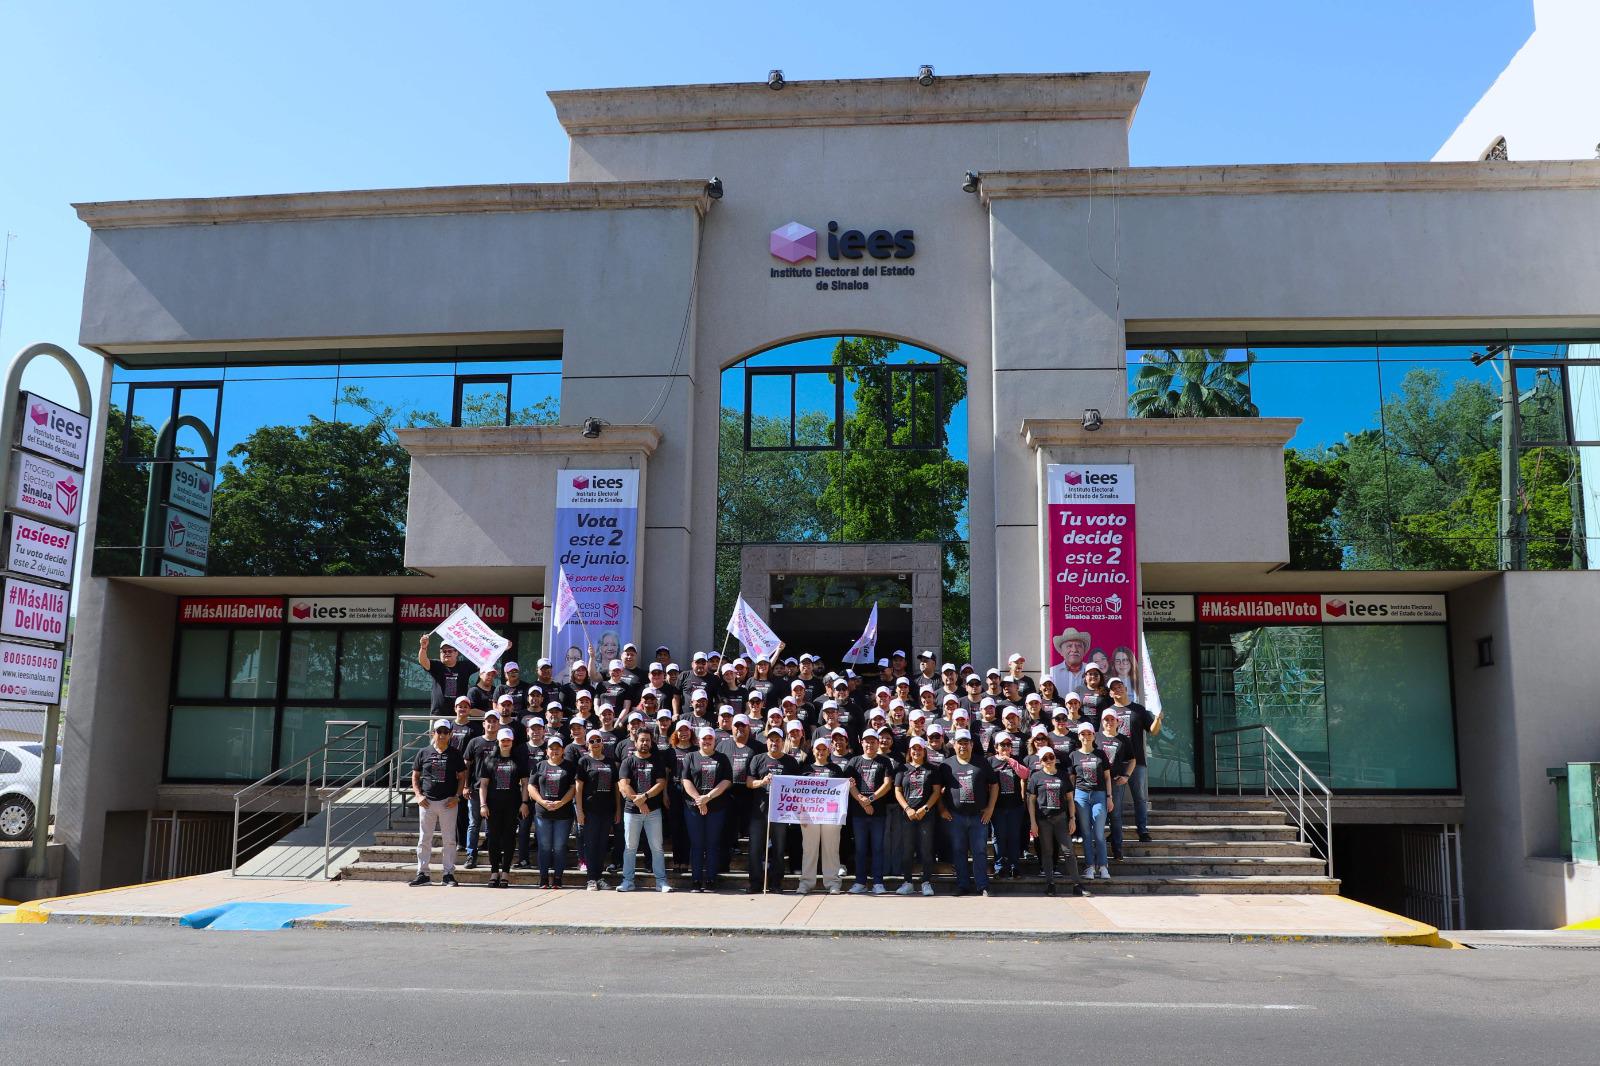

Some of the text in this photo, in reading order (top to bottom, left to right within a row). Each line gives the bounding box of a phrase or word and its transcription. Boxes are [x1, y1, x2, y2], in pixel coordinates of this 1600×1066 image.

[828, 220, 915, 260] iees
[770, 266, 915, 278] Instituto Electoral del Estado
[816, 280, 869, 290] de Sinaloa
[50, 410, 82, 440] iees
[34, 426, 76, 449] Instituto Electoral
[28, 434, 80, 460] del Estado de Sinaloa
[25, 460, 54, 478] Proceso
[24, 472, 54, 490] Electoral
[592, 476, 623, 488] iees
[1086, 471, 1118, 484] iees
[22, 484, 52, 502] Sinaloa
[22, 494, 51, 510] 2023-2024
[577, 514, 618, 528] Vota
[1060, 511, 1127, 526] Tu voto
[16, 525, 70, 550] ¡asíees!
[570, 530, 624, 546] este 2
[1063, 530, 1123, 544] decide
[16, 544, 67, 565] Tu voto decide
[560, 550, 629, 568] de junio.
[1066, 548, 1122, 564] este 2
[14, 558, 66, 577] este 2 de junio.
[600, 574, 610, 582] de
[1056, 568, 1130, 586] de junio.
[10, 586, 63, 613] #MásAllá
[1064, 595, 1102, 604] Proceso
[1147, 598, 1176, 610] iees
[313, 603, 347, 618] iees
[401, 604, 505, 618] #MásAllálVoto
[1064, 604, 1102, 612] Electoral
[1202, 602, 1318, 616] #MásAlláDelVoto
[1350, 600, 1388, 616] iees
[16, 608, 62, 634] DelVoto
[4, 652, 58, 670] 8005050450
[2, 670, 56, 682] www.ieesinaloa.mx
[794, 778, 828, 786] ¡asíees!
[780, 794, 802, 802] Vota
[812, 786, 840, 796] decide
[777, 802, 784, 810] 2
[786, 803, 798, 812] de
[798, 804, 824, 814] junio
